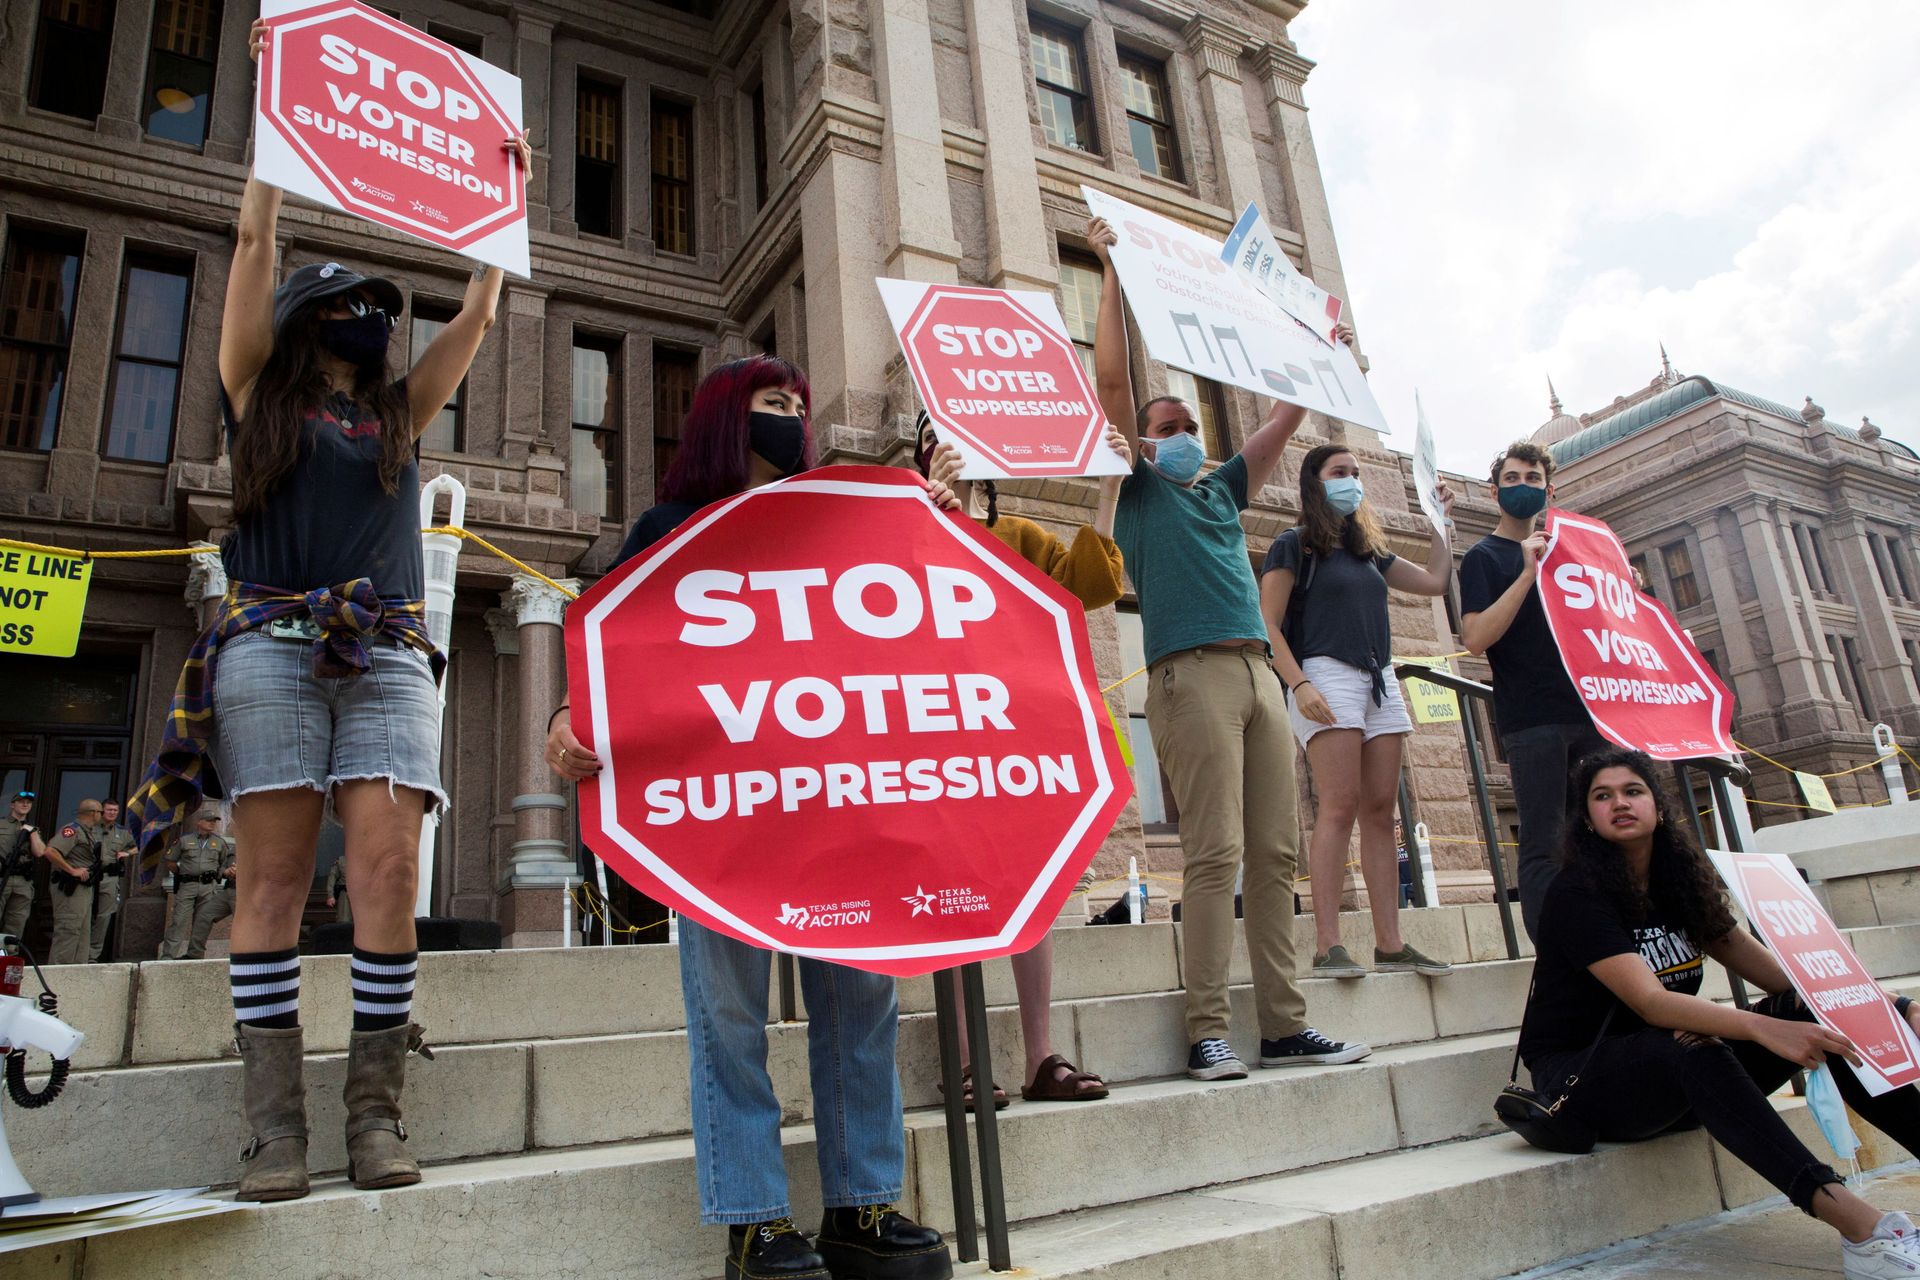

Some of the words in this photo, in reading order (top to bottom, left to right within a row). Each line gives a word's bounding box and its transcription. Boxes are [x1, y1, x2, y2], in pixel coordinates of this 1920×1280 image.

[319, 34, 480, 123] STOP
[325, 81, 475, 167] VOTER
[293, 104, 502, 203] SUPPRESSION
[366, 188, 395, 203] ACTION
[1123, 220, 1226, 276] STOP
[1152, 261, 1201, 289] Voting
[1156, 278, 1222, 309] Obstacle
[932, 323, 1043, 358] STOP
[951, 367, 1060, 393] VOTER
[946, 398, 1088, 416] SUPPRESSION
[27, 555, 84, 580] LINE
[0, 586, 48, 611] NOT
[674, 562, 997, 647] STOP
[1553, 562, 1637, 624] STOP
[0, 623, 34, 646] SS
[1582, 628, 1669, 672] VOTER
[1418, 683, 1431, 696] DO
[1579, 675, 1708, 705] SUPPRESSION
[697, 673, 1017, 743] VOTER
[1427, 703, 1454, 718] CROSS
[644, 754, 1081, 826] SUPPRESSION
[809, 903, 838, 913] TEXAS
[841, 900, 871, 909] RISING
[938, 887, 972, 898] TEXAS
[939, 895, 987, 907] FREEDOM
[809, 910, 871, 928] ACTION
[940, 902, 990, 916] NETWORK
[1758, 899, 1818, 937] STOP
[1792, 949, 1852, 980] VOTER
[1811, 983, 1881, 1012] SUPPRESSION
